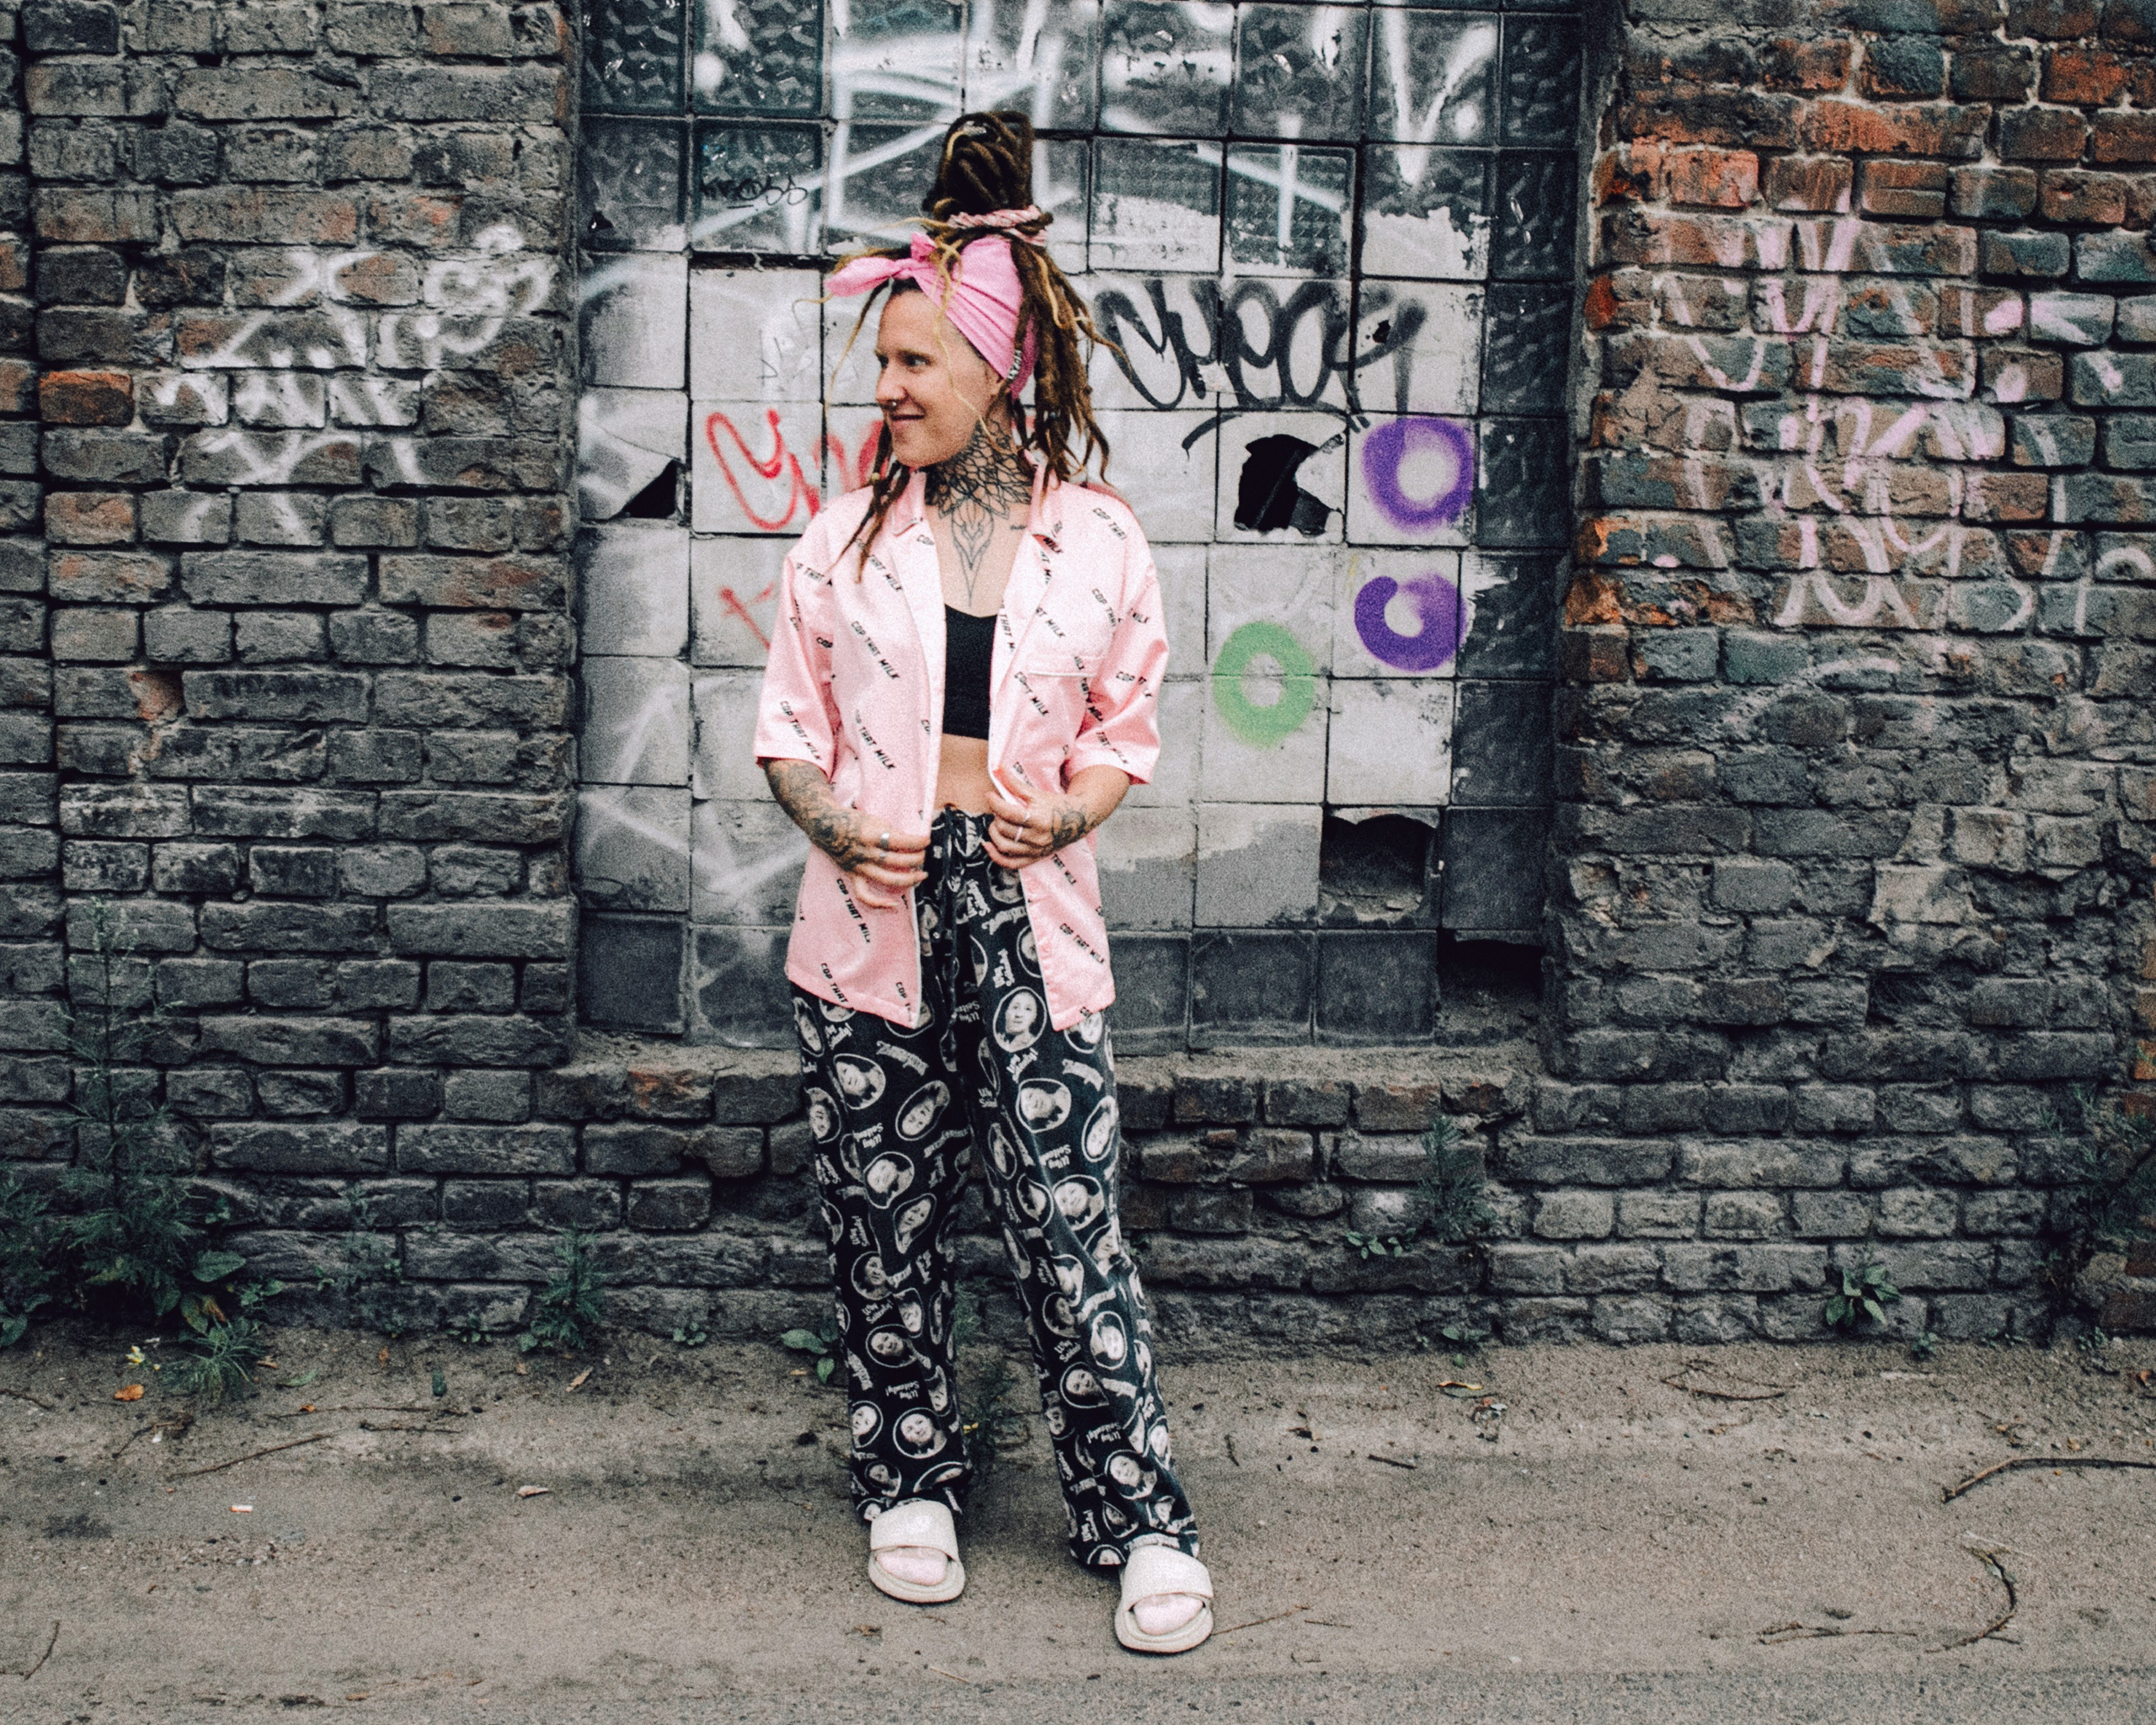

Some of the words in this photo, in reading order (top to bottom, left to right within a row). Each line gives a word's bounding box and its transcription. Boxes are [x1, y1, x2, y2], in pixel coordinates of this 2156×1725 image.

[884, 574, 903, 592] MILK
[1091, 588, 1107, 604] COP
[1045, 619, 1065, 638] MILK
[851, 621, 866, 636] COP
[864, 637, 881, 657] THAT
[878, 659, 900, 681] MILK
[1031, 697, 1049, 716] MILK
[780, 700, 793, 717] COP
[790, 718, 808, 739] THAT
[804, 741, 822, 761] MILK
[859, 727, 877, 746] THAT
[874, 750, 897, 770] MILK
[836, 879, 849, 895] COP
[845, 898, 862, 920] THAT
[858, 922, 871, 943] MILK
[1059, 922, 1075, 935] COP
[820, 963, 833, 980] COP
[830, 982, 849, 1003] THAT
[895, 981, 908, 999] COP
